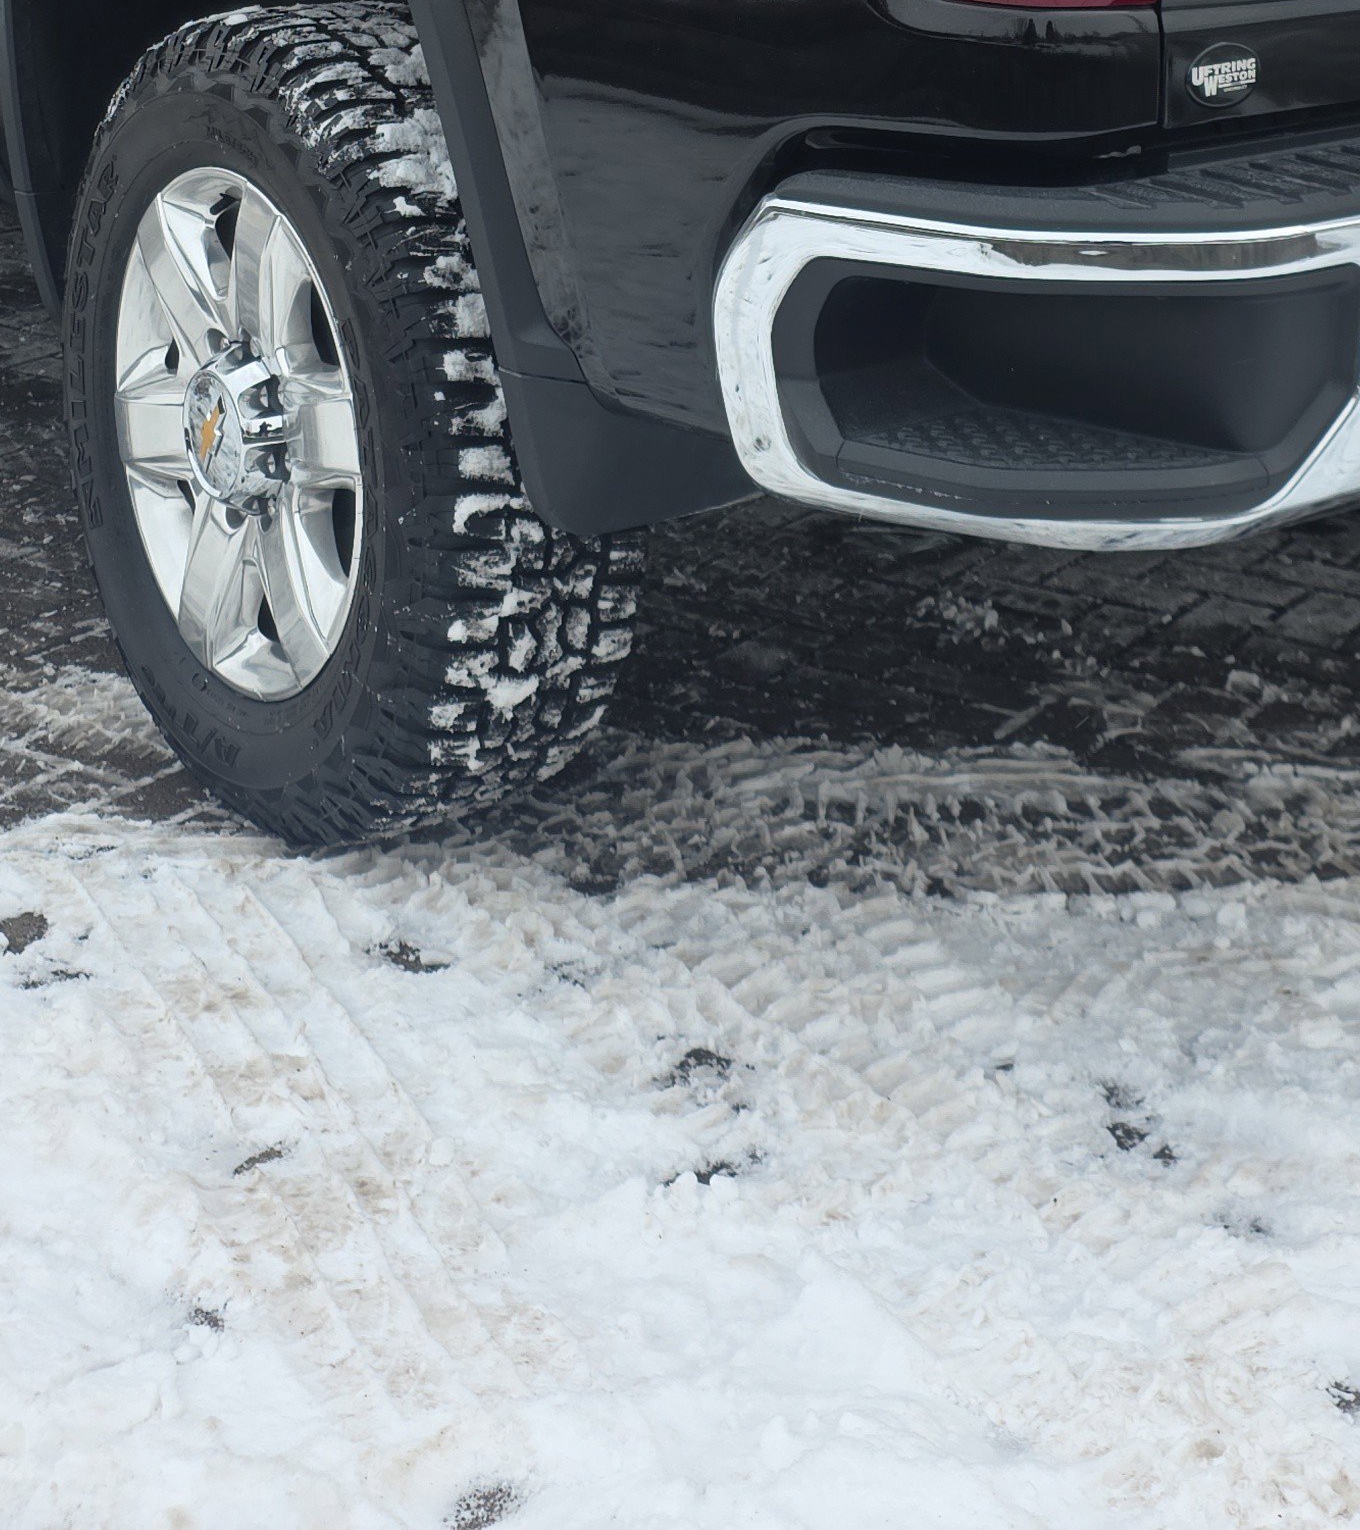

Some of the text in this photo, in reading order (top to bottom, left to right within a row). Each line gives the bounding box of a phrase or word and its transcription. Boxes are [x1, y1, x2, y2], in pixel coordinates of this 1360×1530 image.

[1191, 57, 1256, 87] UFTRING
[1203, 69, 1256, 98] WESTON
[69, 159, 121, 478] MILESTAR
[314, 318, 379, 741] PATAGONIA
